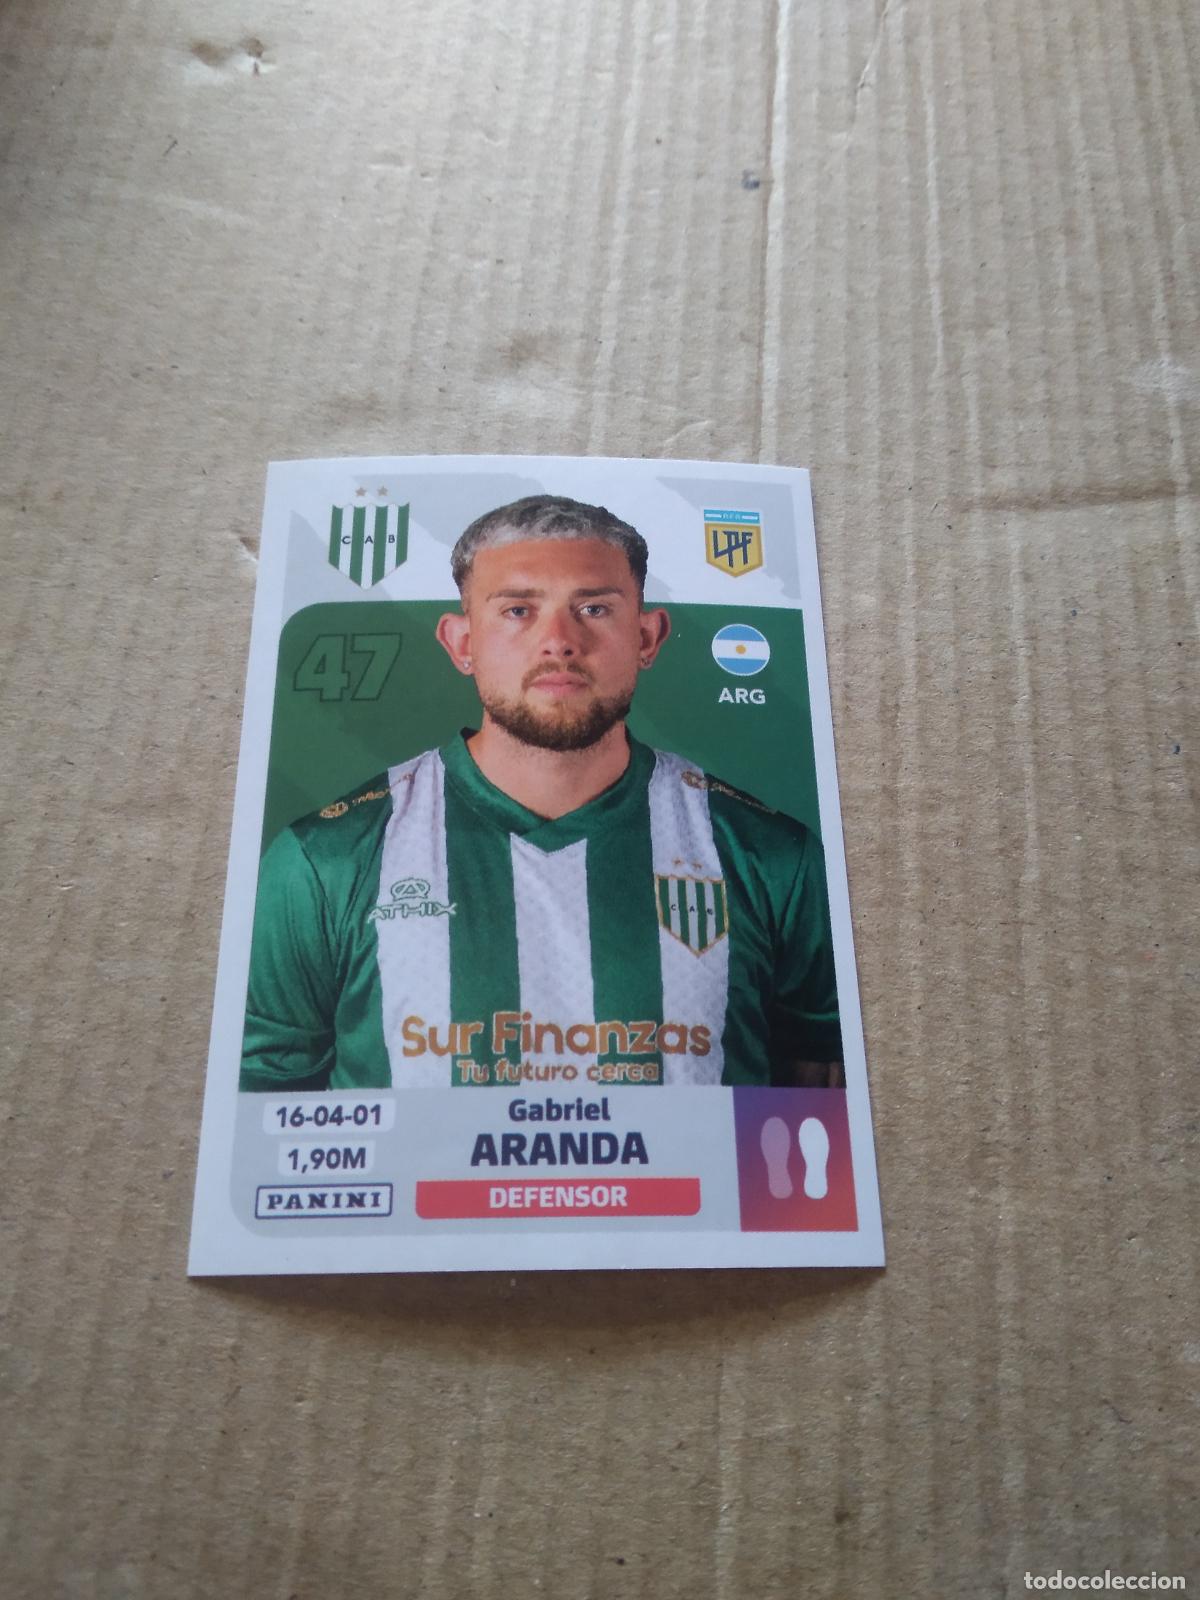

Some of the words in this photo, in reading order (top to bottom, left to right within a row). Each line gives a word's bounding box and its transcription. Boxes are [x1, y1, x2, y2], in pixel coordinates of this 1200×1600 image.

[293, 633, 402, 702] 47
[718, 687, 766, 705] ARG
[401, 1015, 484, 1057] Sur
[492, 1010, 712, 1056] Finanzas
[456, 1060, 489, 1083] Tu
[495, 1058, 578, 1081] futuro
[586, 1061, 659, 1081] cerca
[276, 1104, 382, 1128] 16-04-01
[508, 1097, 611, 1122] Gabriel
[288, 1147, 367, 1174] 1,90M
[470, 1132, 649, 1167] ARANDA
[266, 1192, 382, 1211] PANINI
[489, 1186, 628, 1209] DEFENSOR
